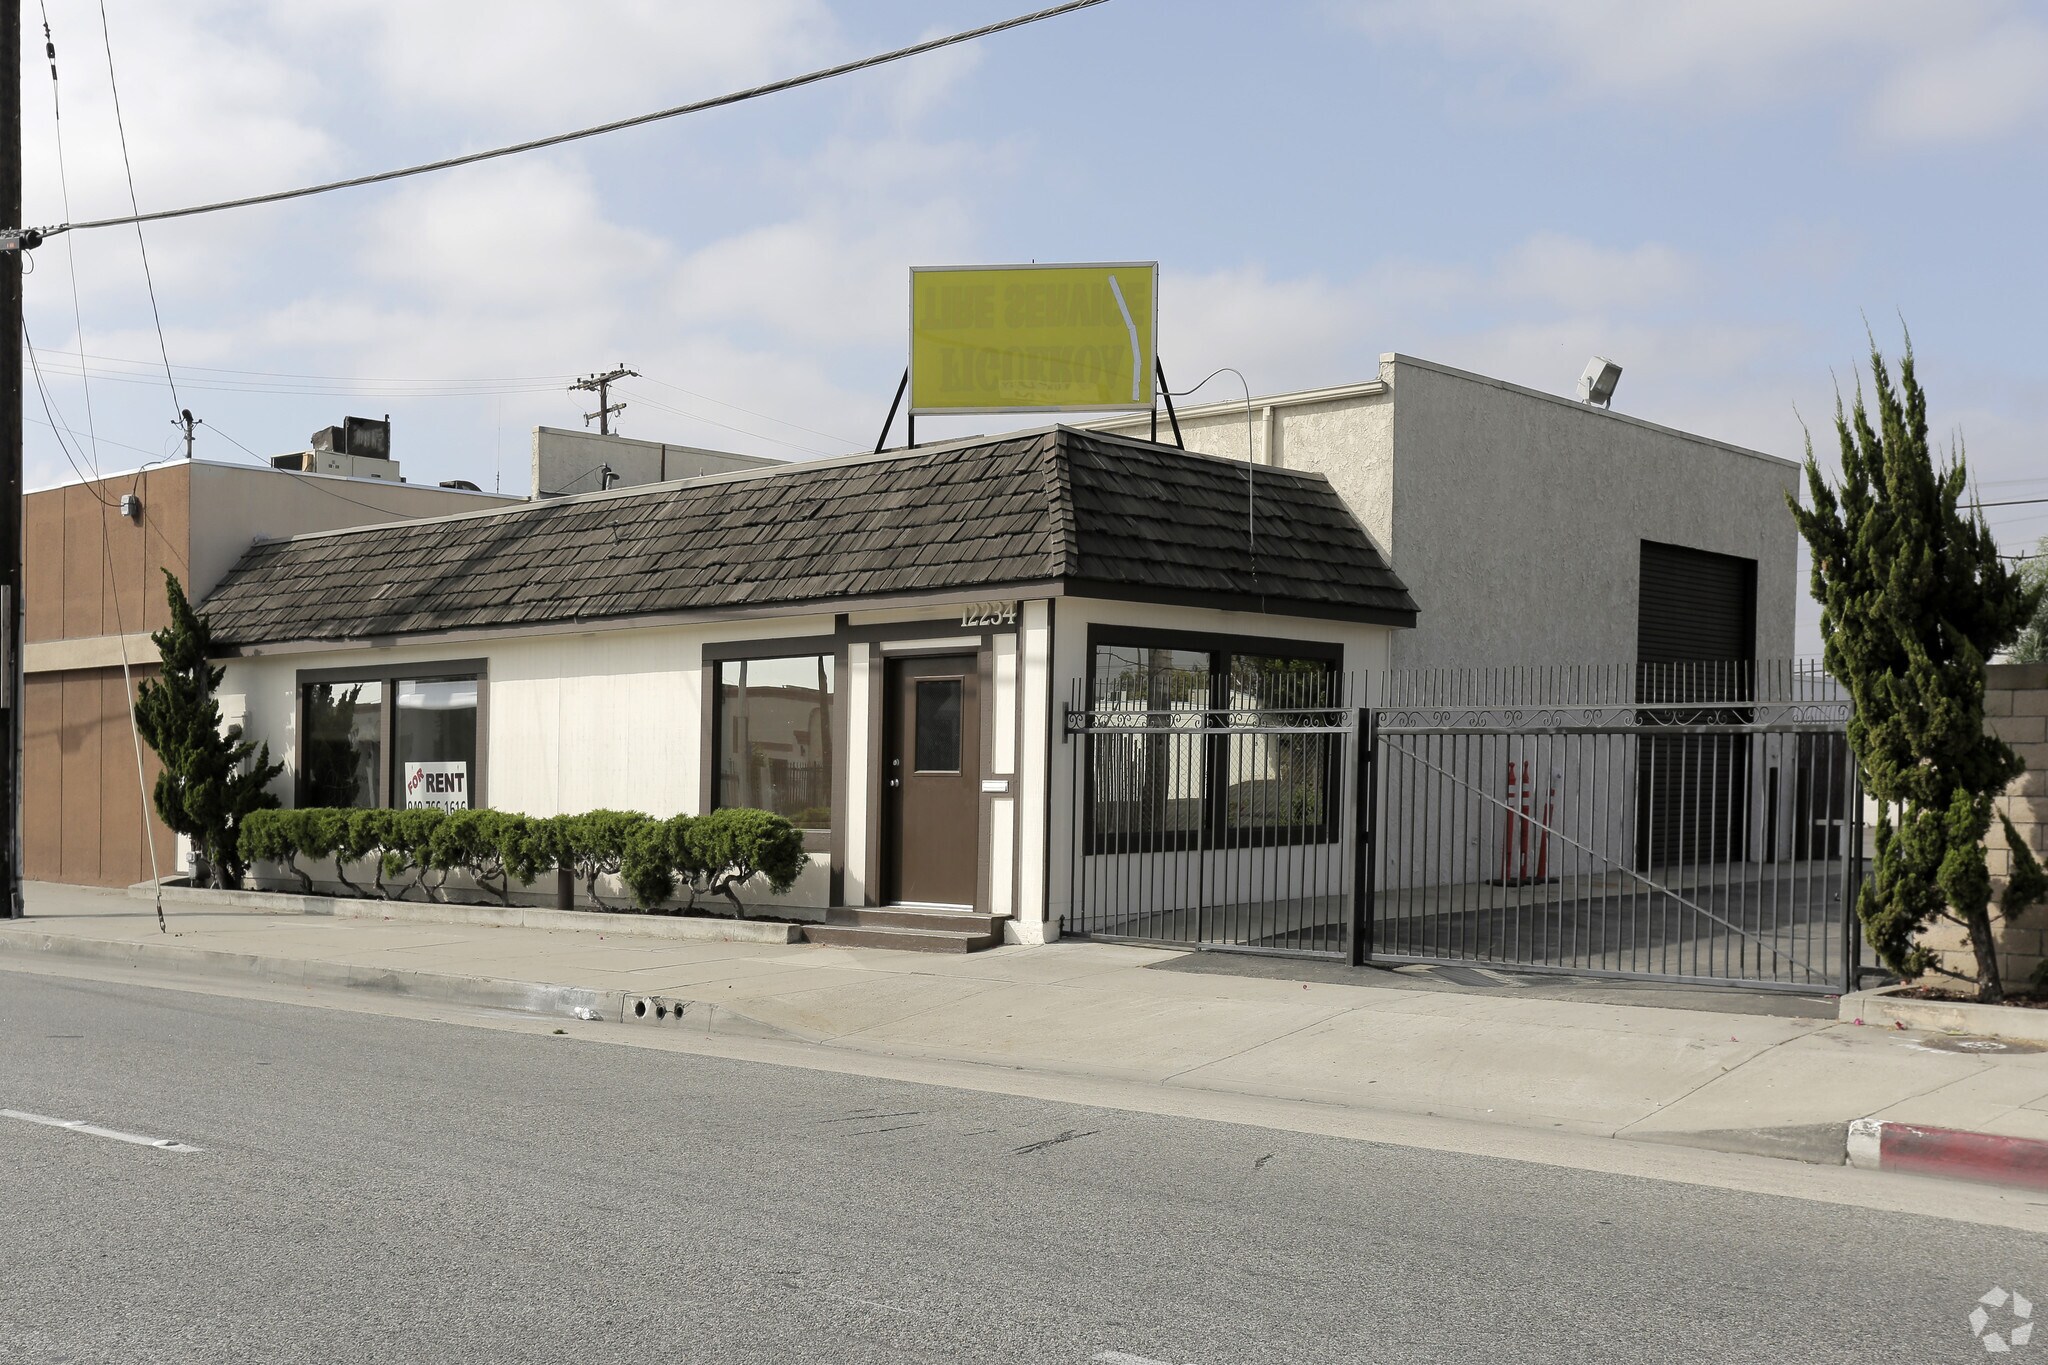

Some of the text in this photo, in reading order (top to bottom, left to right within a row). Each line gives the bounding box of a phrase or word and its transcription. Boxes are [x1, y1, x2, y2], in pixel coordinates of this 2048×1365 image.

[961, 600, 1016, 627] 12234
[408, 768, 464, 795] FOR RENT
